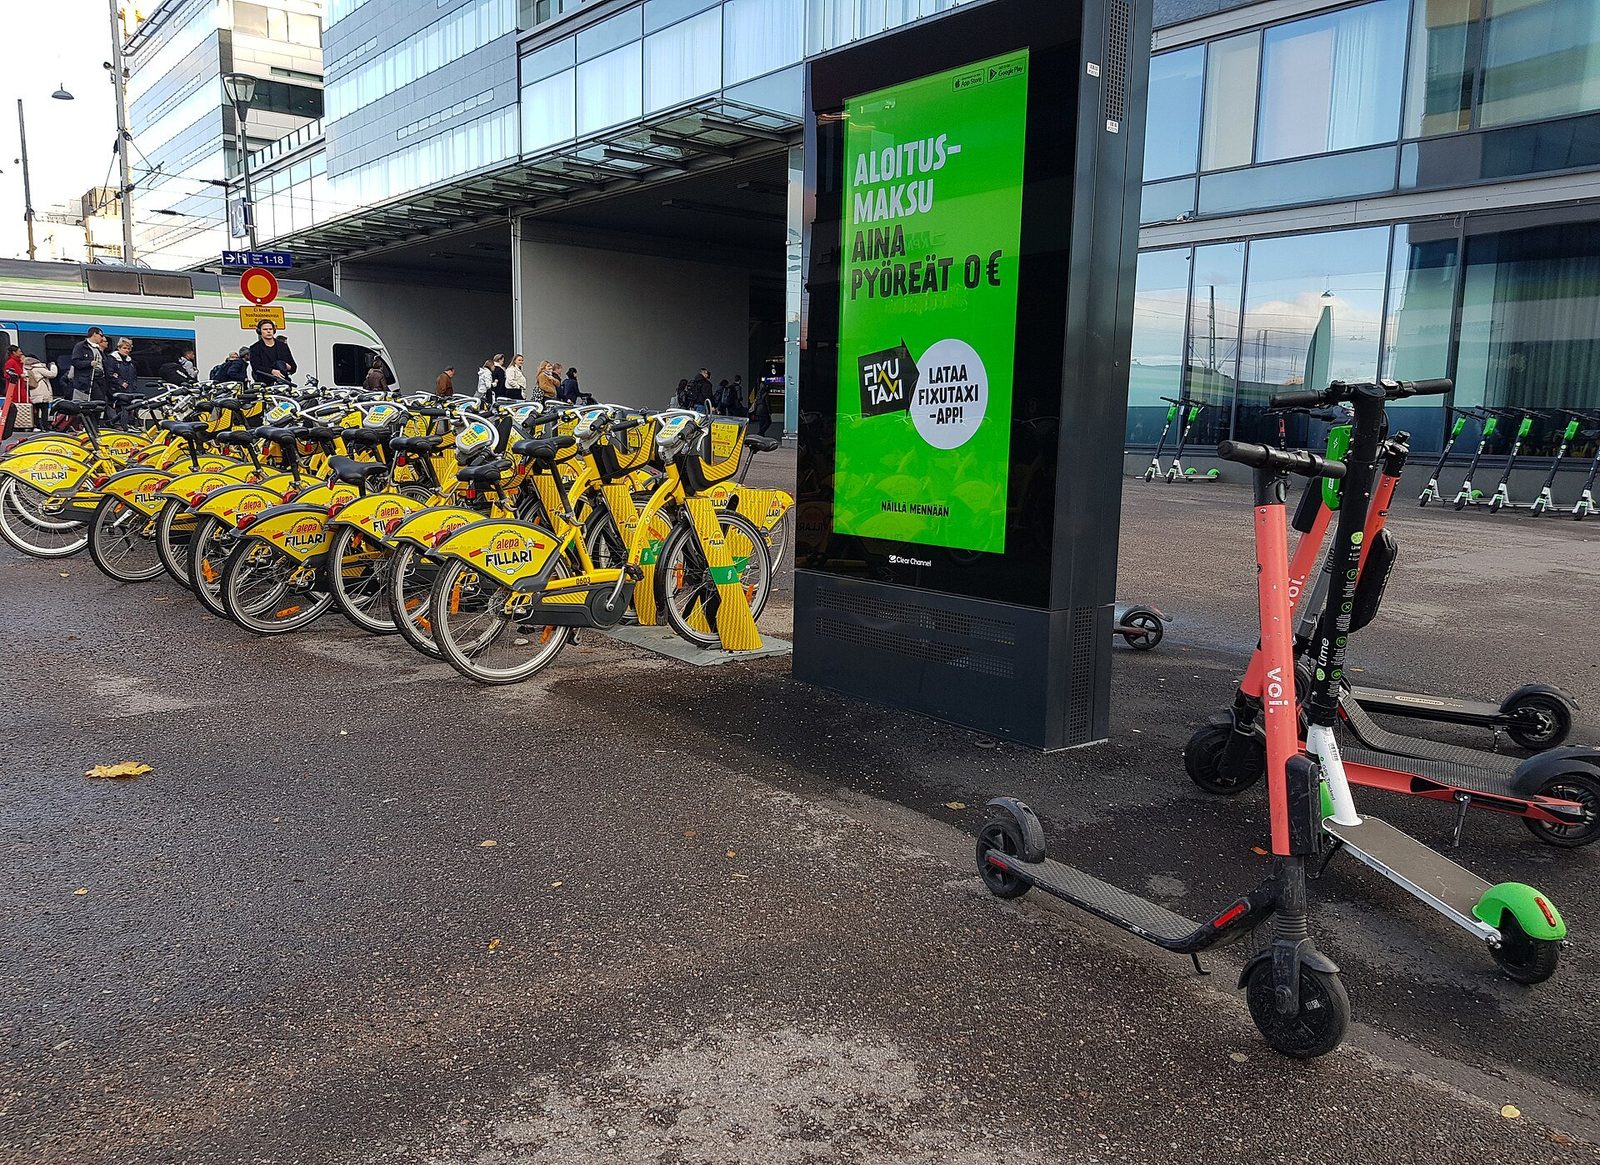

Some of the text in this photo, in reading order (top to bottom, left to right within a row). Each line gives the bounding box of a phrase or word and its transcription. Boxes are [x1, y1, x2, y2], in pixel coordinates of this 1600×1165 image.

[998, 68, 1014, 77] Google
[853, 133, 962, 187] ALOITUS-
[853, 178, 934, 225] MAKSU
[851, 224, 906, 263] AINA
[264, 255, 285, 265] 1-18
[851, 249, 1003, 300] PYÖREÄT 0 €
[864, 358, 900, 386] FIXU
[929, 364, 968, 385] LATAA
[867, 378, 904, 406] TAXI
[918, 384, 979, 406] FIXUTAXI
[929, 406, 964, 425] -APP!
[30, 471, 68, 481] FILLARI
[243, 500, 262, 510] alepa
[380, 506, 399, 517] alepa
[881, 499, 950, 517] NÄILLÄ MENNÄÄN
[296, 522, 318, 533] alepa
[284, 533, 327, 548] FILLARI
[496, 537, 520, 550] alepa
[485, 550, 533, 568] FILLARI
[896, 556, 932, 567] Clear Channel
[575, 576, 591, 585] 0603
[1317, 637, 1330, 667] Lime
